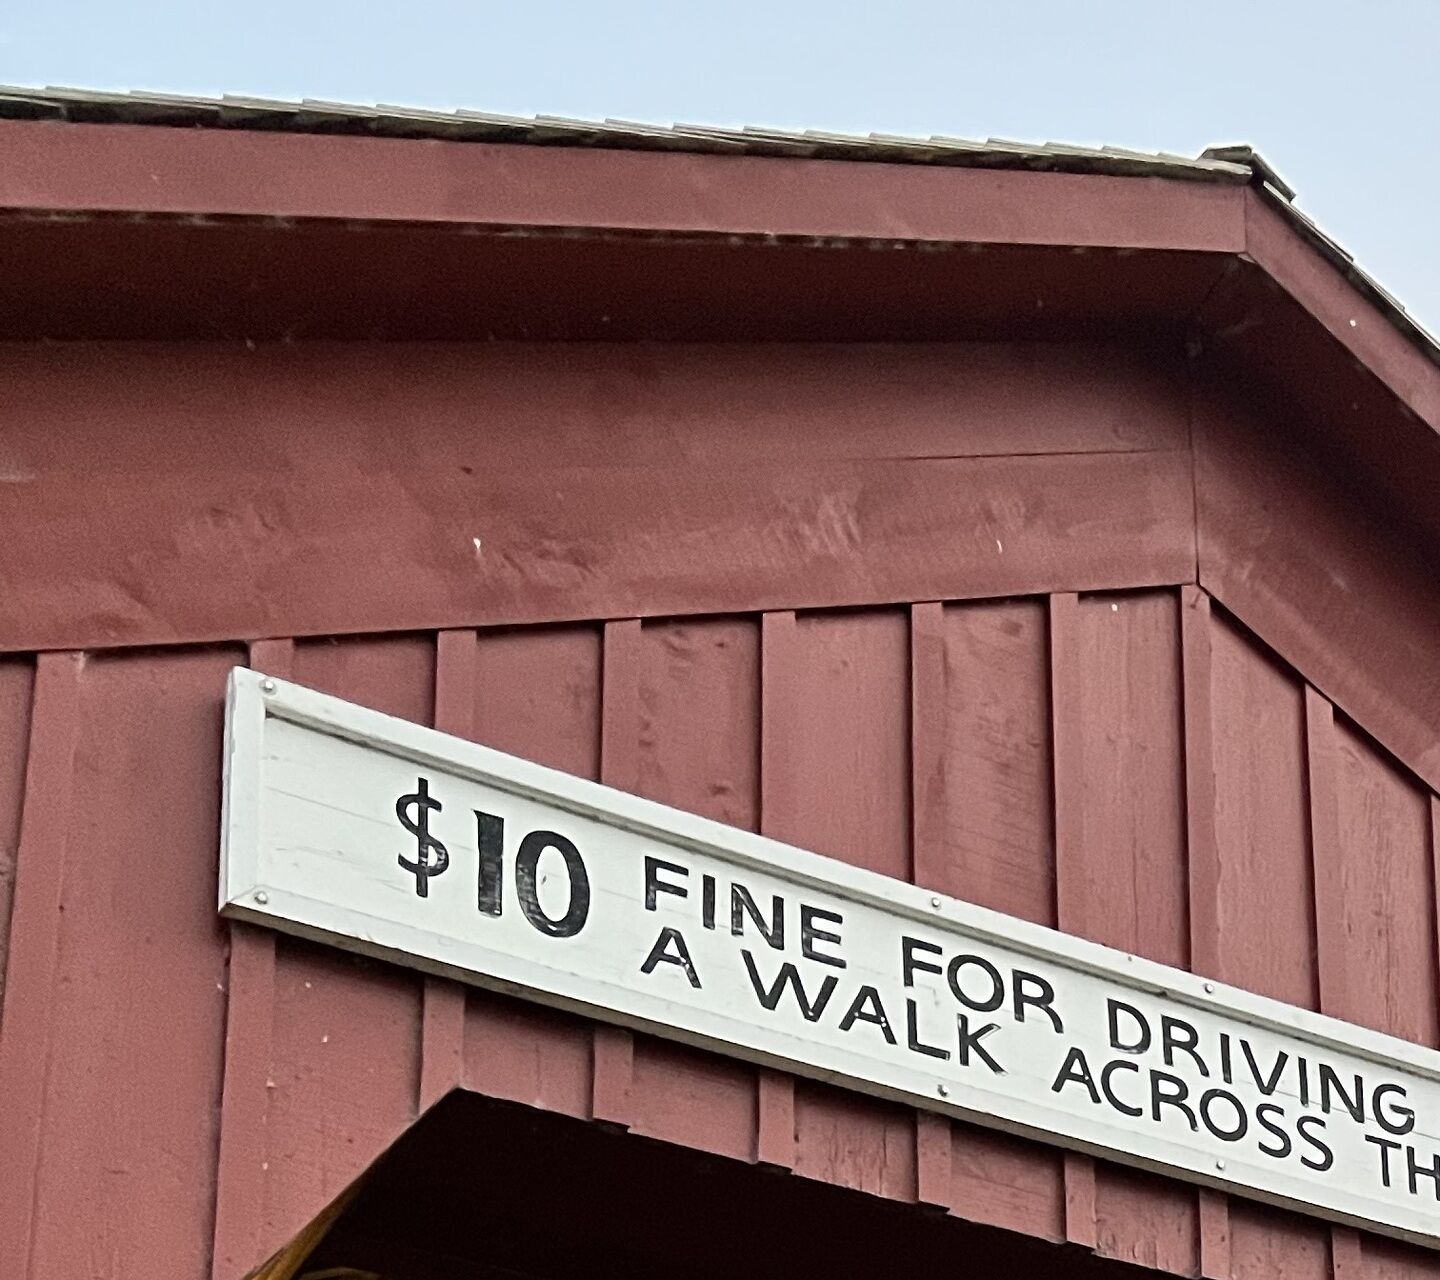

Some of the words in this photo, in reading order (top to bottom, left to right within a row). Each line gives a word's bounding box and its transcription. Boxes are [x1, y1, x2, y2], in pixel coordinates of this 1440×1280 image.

[395, 776, 591, 938] $10
[644, 855, 848, 969] FINE
[901, 935, 1064, 1035] FOR
[1107, 998, 1415, 1136] DRIVING
[640, 926, 703, 989] A
[740, 949, 1006, 1074] WALK
[1051, 1046, 1334, 1172] ACROSS
